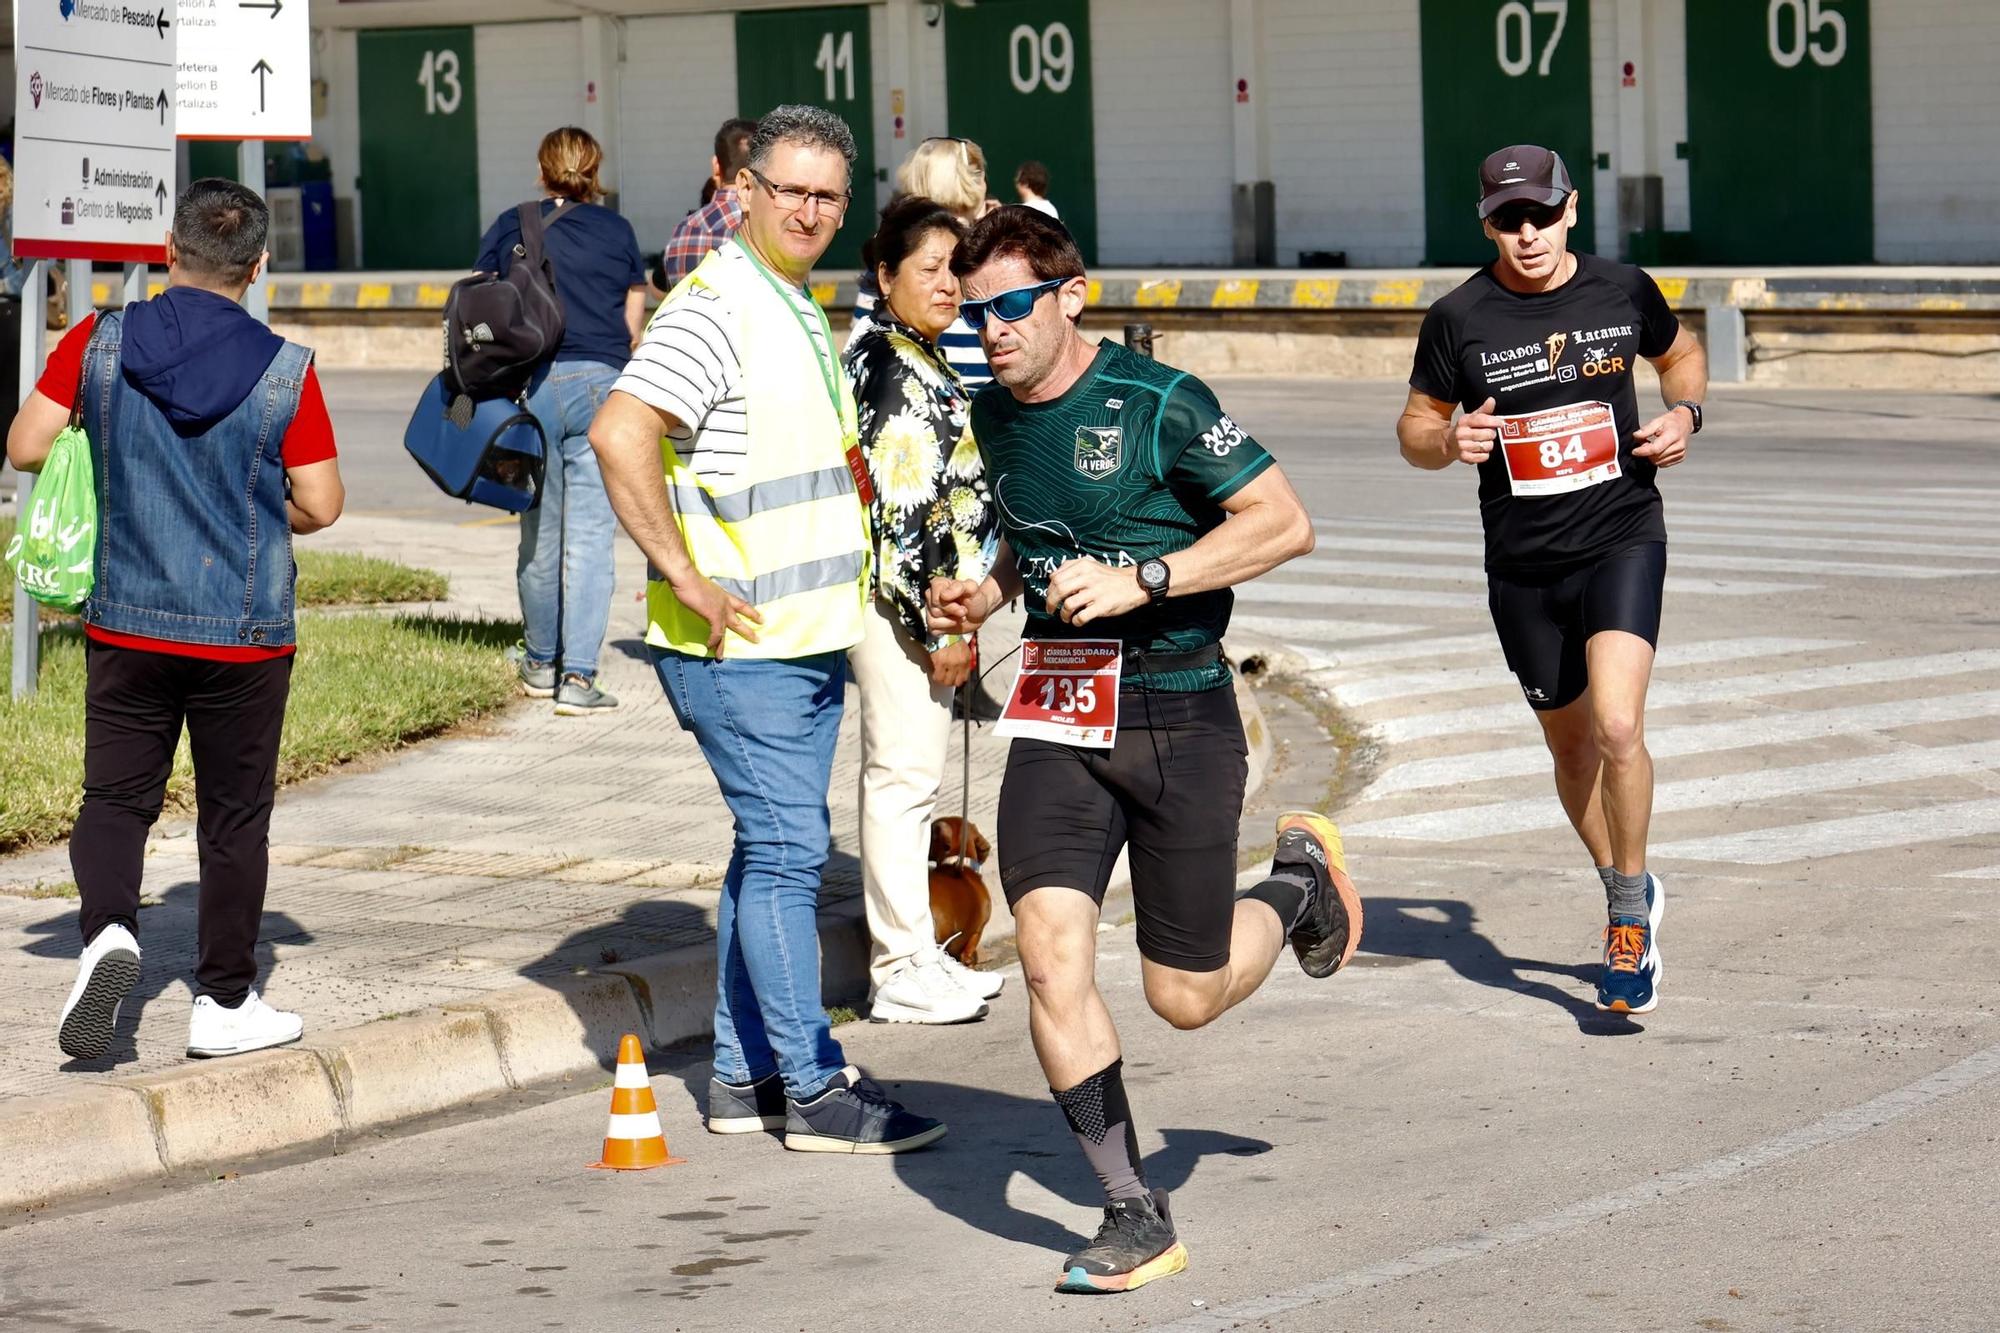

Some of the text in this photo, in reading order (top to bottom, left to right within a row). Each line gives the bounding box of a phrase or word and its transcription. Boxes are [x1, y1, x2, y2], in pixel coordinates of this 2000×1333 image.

[75, 0, 155, 28] Mercado de Pescado
[176, 16, 216, 27] rtalizas
[1497, 0, 1568, 76] 07
[1768, 0, 1846, 67] 05
[815, 31, 855, 101] 11
[1010, 22, 1074, 93] 09
[210, 80, 218, 90] B
[417, 49, 462, 114] 13
[45, 81, 154, 111] Mercado de Flores y Plantas
[176, 98, 218, 108] rtalizas
[94, 167, 153, 189] Administración
[77, 197, 153, 224] Centro de Negocios
[1572, 325, 1633, 344] Lacamar
[1513, 367, 1535, 378] Madrid
[1582, 357, 1625, 377] OCR
[1539, 434, 1587, 468] 84
[1079, 457, 1116, 471] LA VERDE
[1044, 656, 1087, 664] MERCAMURCIA
[1047, 648, 1072, 657] CARRERA
[1072, 648, 1116, 657] SOLIDARIA
[1040, 677, 1097, 713] 135
